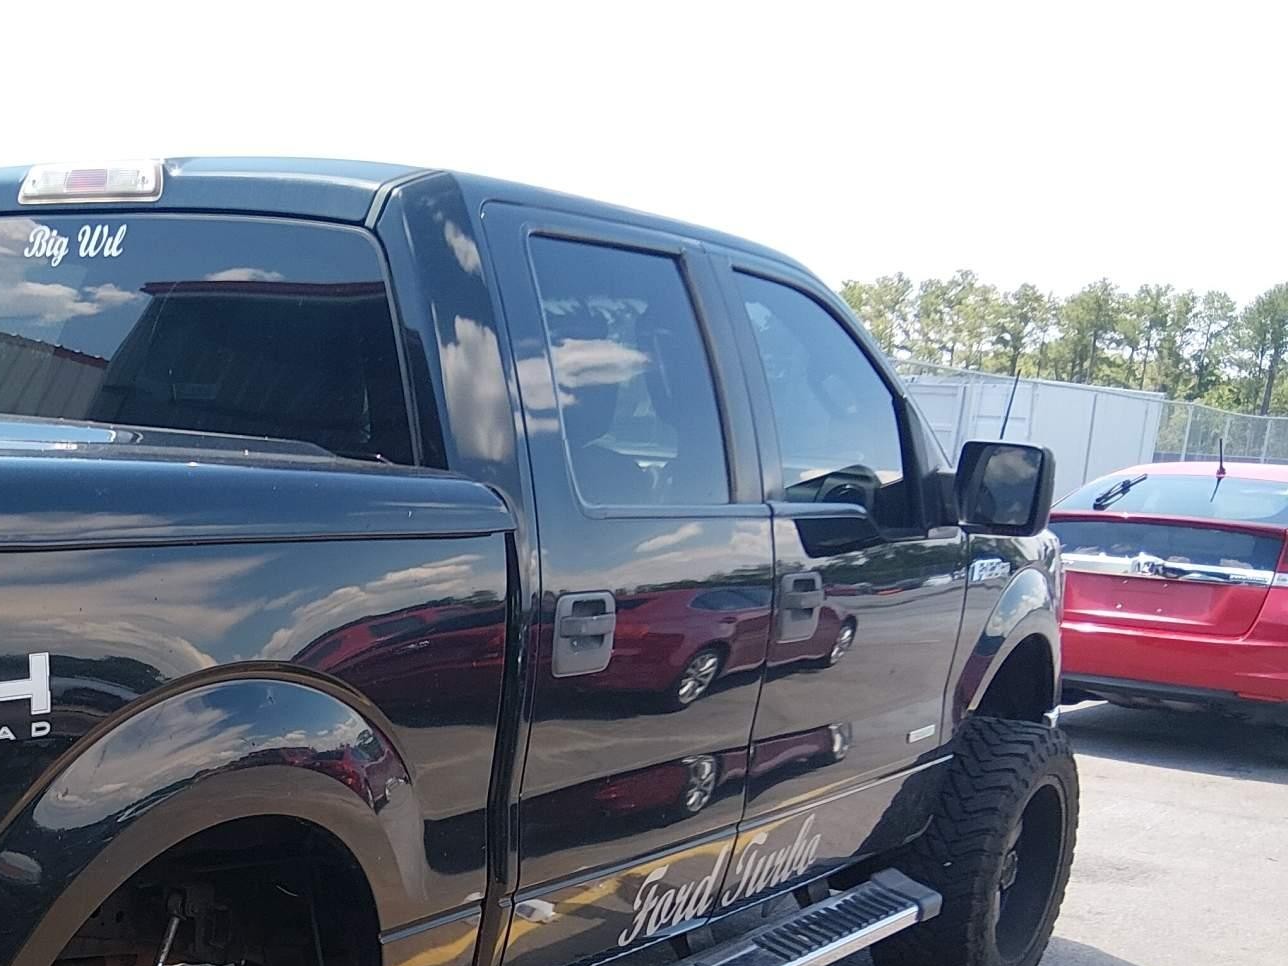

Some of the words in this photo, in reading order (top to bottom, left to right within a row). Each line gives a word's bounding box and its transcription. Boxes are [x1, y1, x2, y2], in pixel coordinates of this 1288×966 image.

[24, 225, 69, 267] Big
[618, 843, 730, 946] Ford
[721, 813, 822, 907] Turbo
